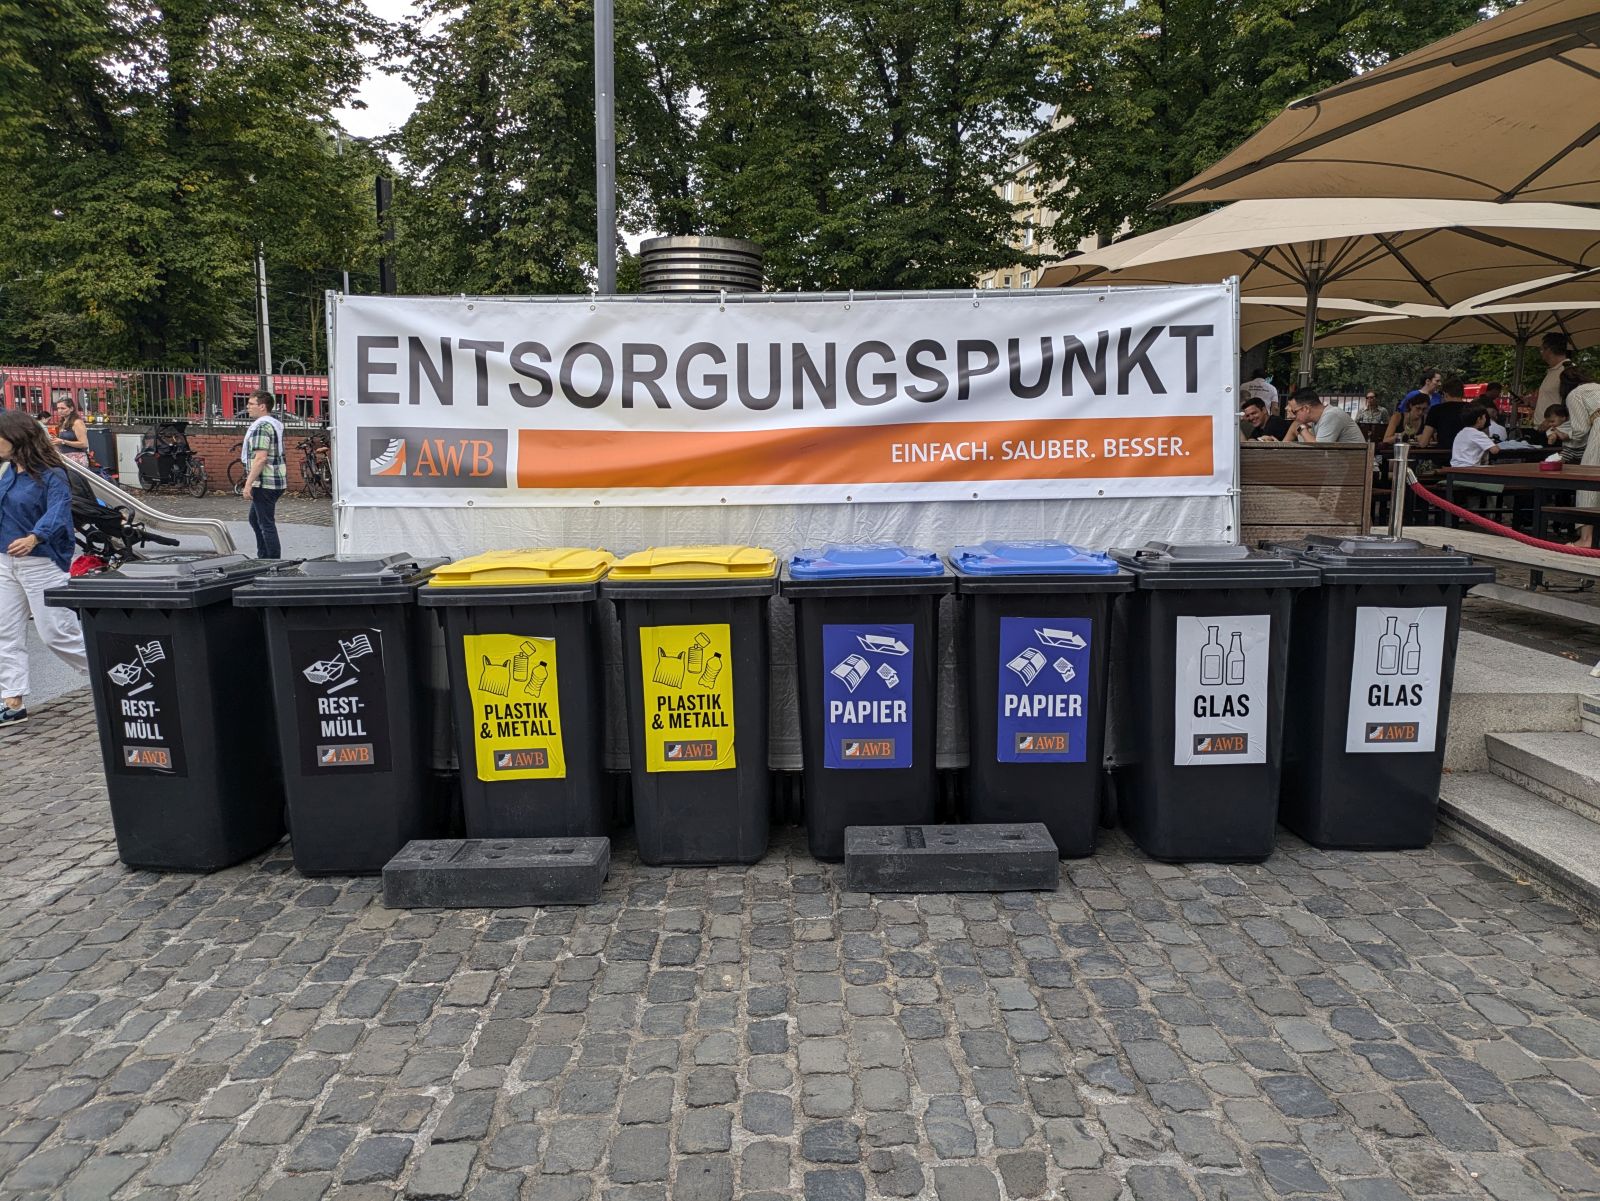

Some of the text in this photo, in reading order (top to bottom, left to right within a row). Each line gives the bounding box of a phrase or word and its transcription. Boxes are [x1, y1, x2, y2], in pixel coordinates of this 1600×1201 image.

[357, 325, 1214, 411] ENTSORGUNGSPUNKT
[413, 439, 494, 477] AWB
[892, 436, 1190, 464] EINFACH. SAUBER. BESSER.
[657, 694, 722, 711] PLASTIK
[1368, 684, 1423, 707] GLAS
[121, 699, 161, 718] REST-
[318, 697, 365, 715] REST-
[484, 702, 549, 721] PLASTIK
[830, 700, 907, 723] PAPIER
[1004, 694, 1082, 717] PAPIER
[1193, 694, 1250, 718] GLAS
[321, 716, 366, 738] MÜLL
[480, 720, 556, 739] & METALL
[651, 711, 729, 729] & METALL
[124, 720, 164, 740] MÜLL
[1386, 725, 1415, 739] AWB
[683, 743, 713, 758] AWB
[861, 742, 891, 756] AWB
[1034, 736, 1065, 750] AWB
[1213, 736, 1244, 751] AWB
[141, 751, 168, 765] AWB
[338, 747, 369, 761] AWB
[514, 751, 544, 767] AWB
